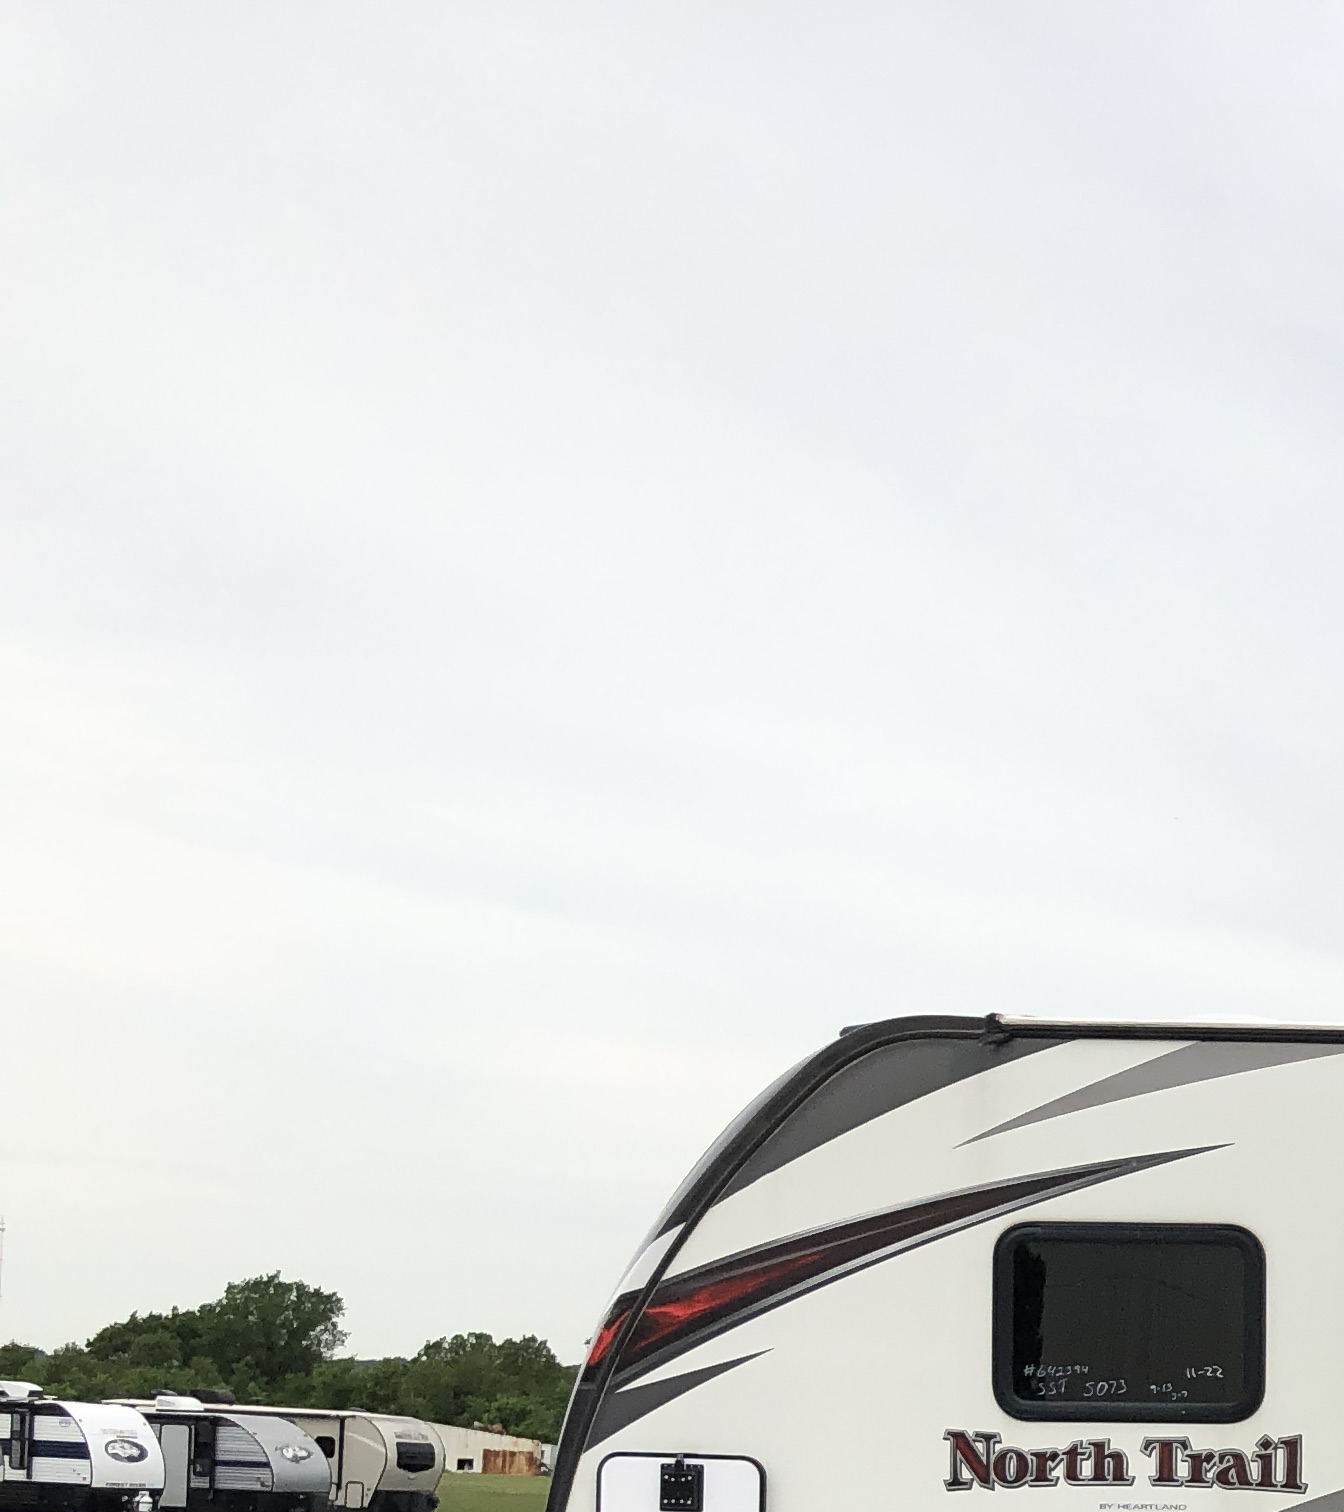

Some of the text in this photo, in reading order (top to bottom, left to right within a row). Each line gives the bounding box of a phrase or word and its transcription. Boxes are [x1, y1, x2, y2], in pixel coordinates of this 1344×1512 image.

[1186, 1365, 1224, 1379] 11-22
[943, 1428, 1309, 1494] North Trail
[1117, 1503, 1188, 1511] HEARTLAND
